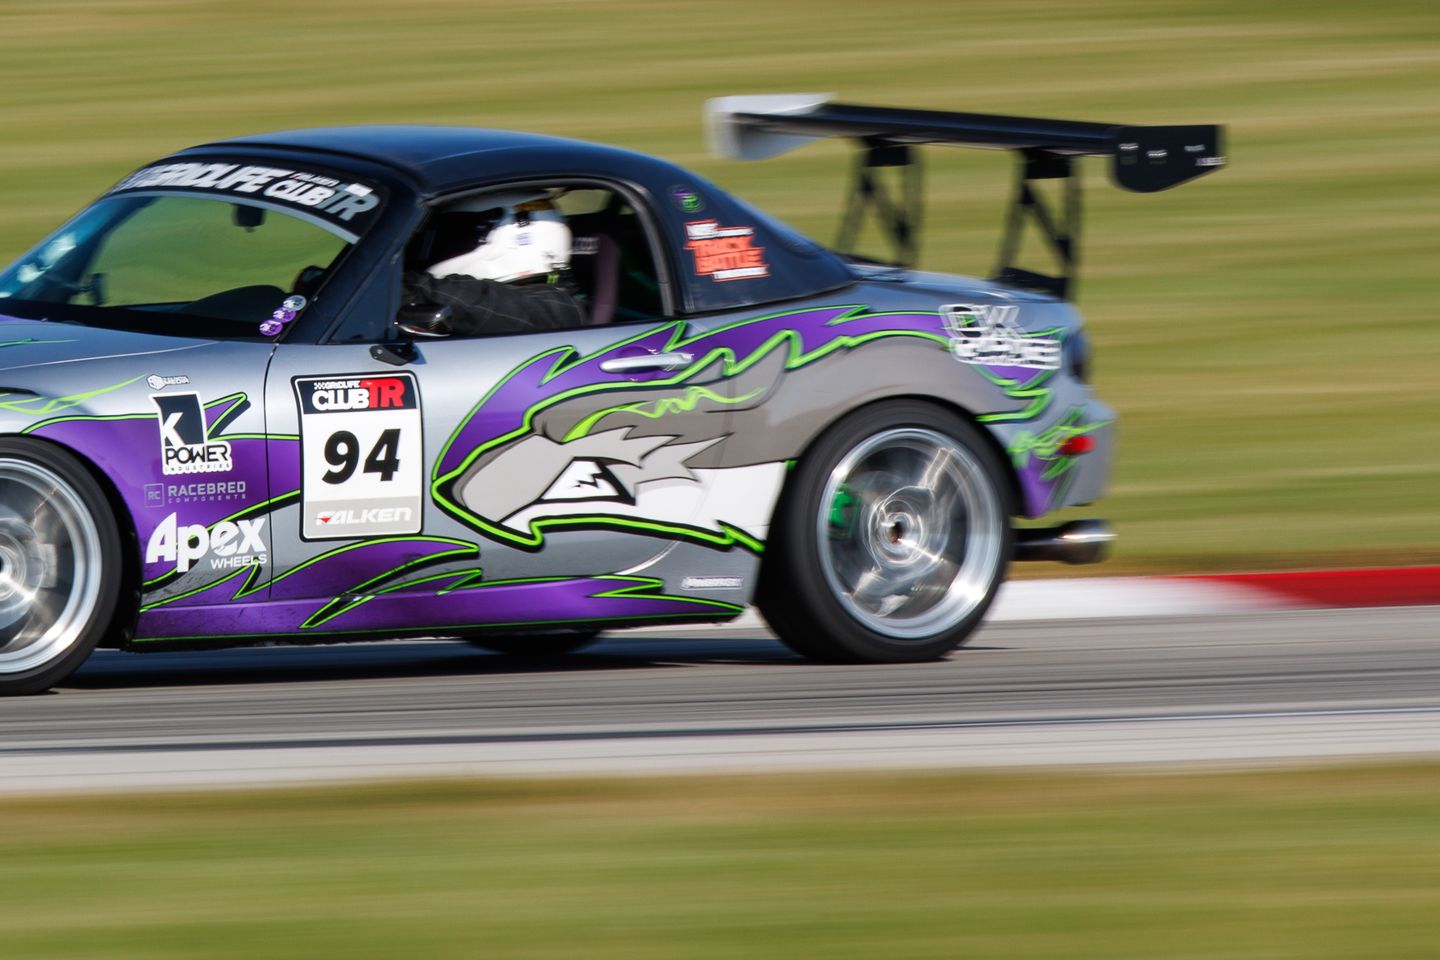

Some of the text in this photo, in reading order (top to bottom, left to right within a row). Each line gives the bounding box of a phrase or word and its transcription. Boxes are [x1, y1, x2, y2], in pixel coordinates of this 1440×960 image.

[165, 444, 229, 465] POWER
[322, 428, 401, 485] 94
[168, 481, 246, 497] RACEBRED
[146, 512, 267, 572] Apex
[211, 554, 268, 570] WHEELS
